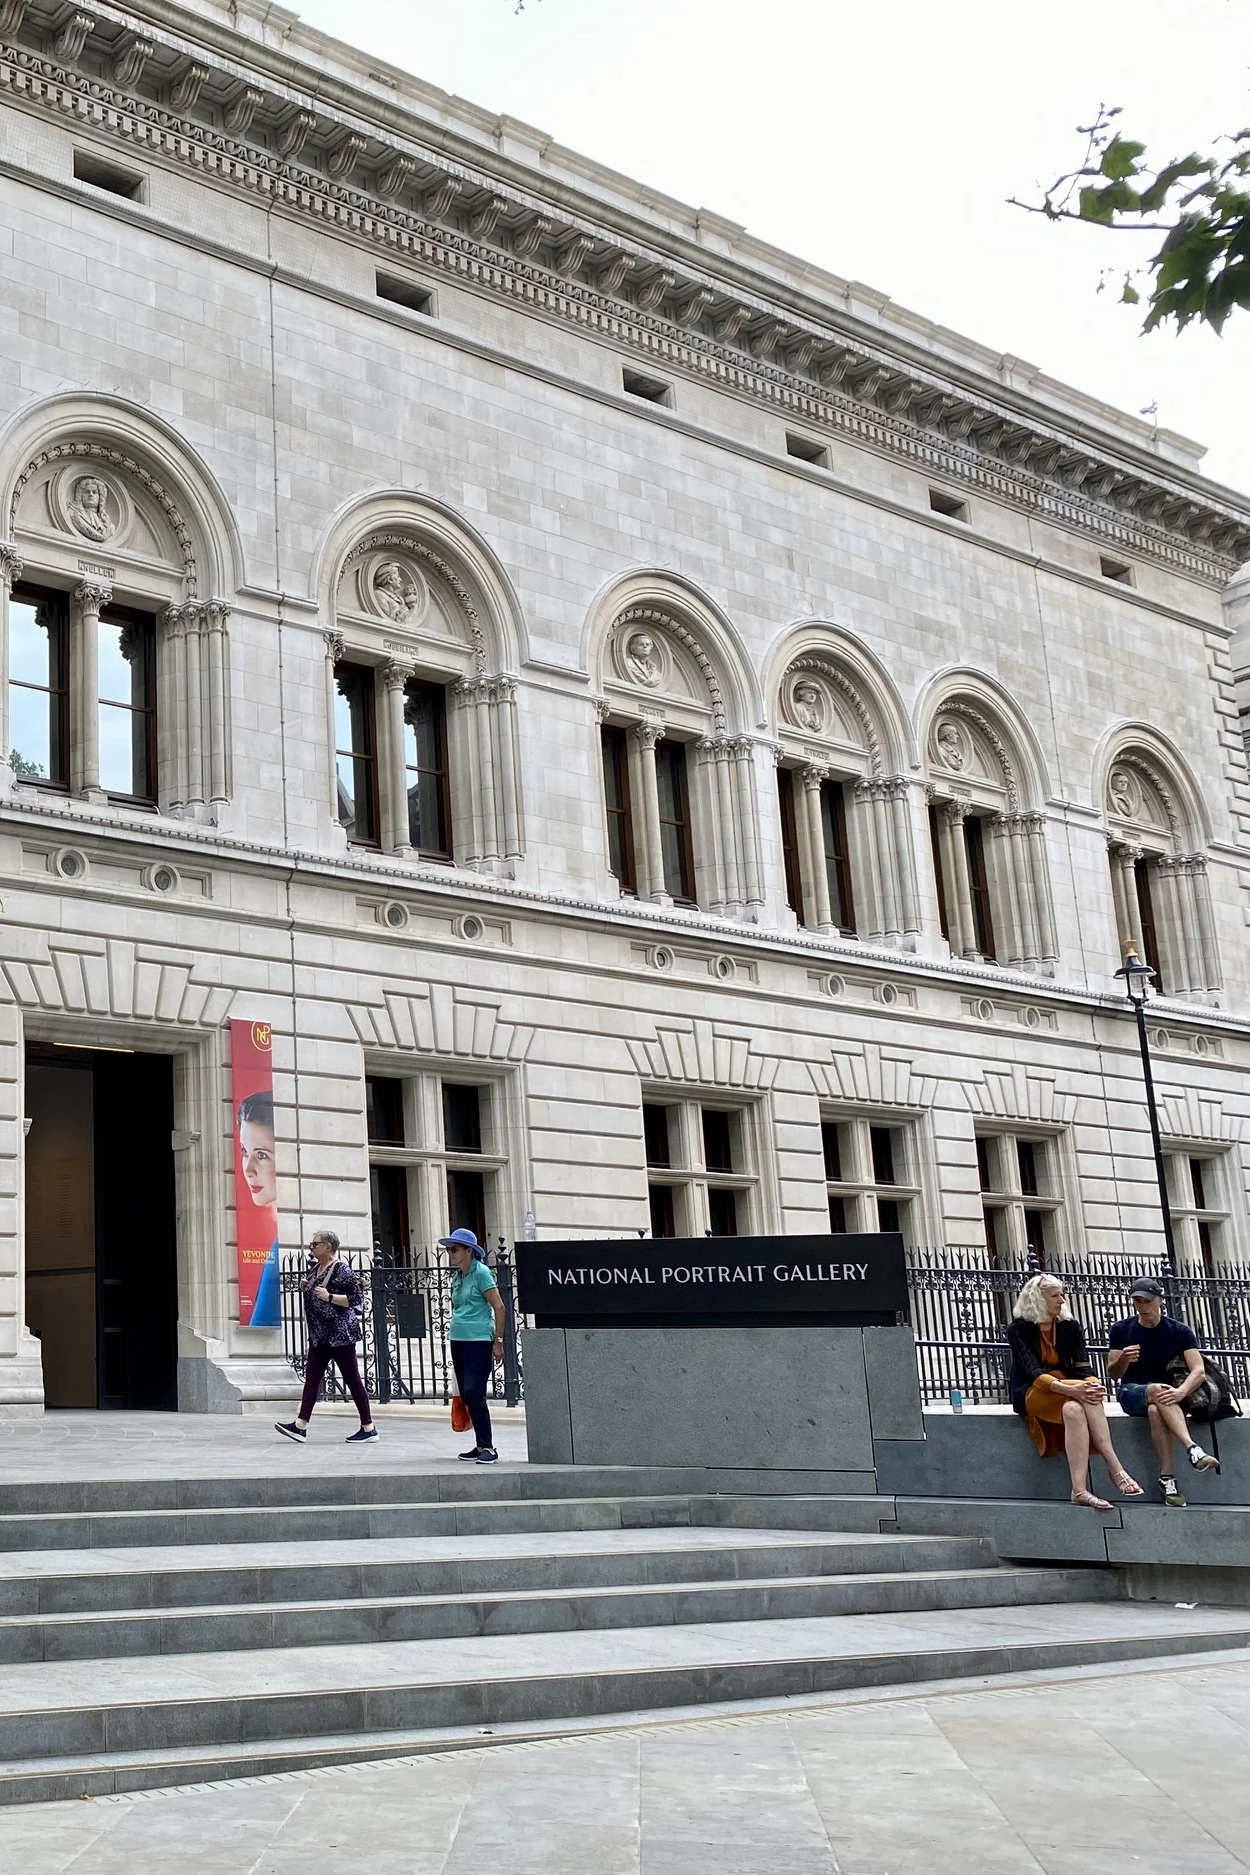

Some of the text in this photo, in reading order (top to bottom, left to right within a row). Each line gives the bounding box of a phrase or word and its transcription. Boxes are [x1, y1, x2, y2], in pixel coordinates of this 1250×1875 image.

[242, 1250, 276, 1259] YEVONDE
[547, 1263, 869, 1285] NATIONAL PORTRAIT GALLERY
